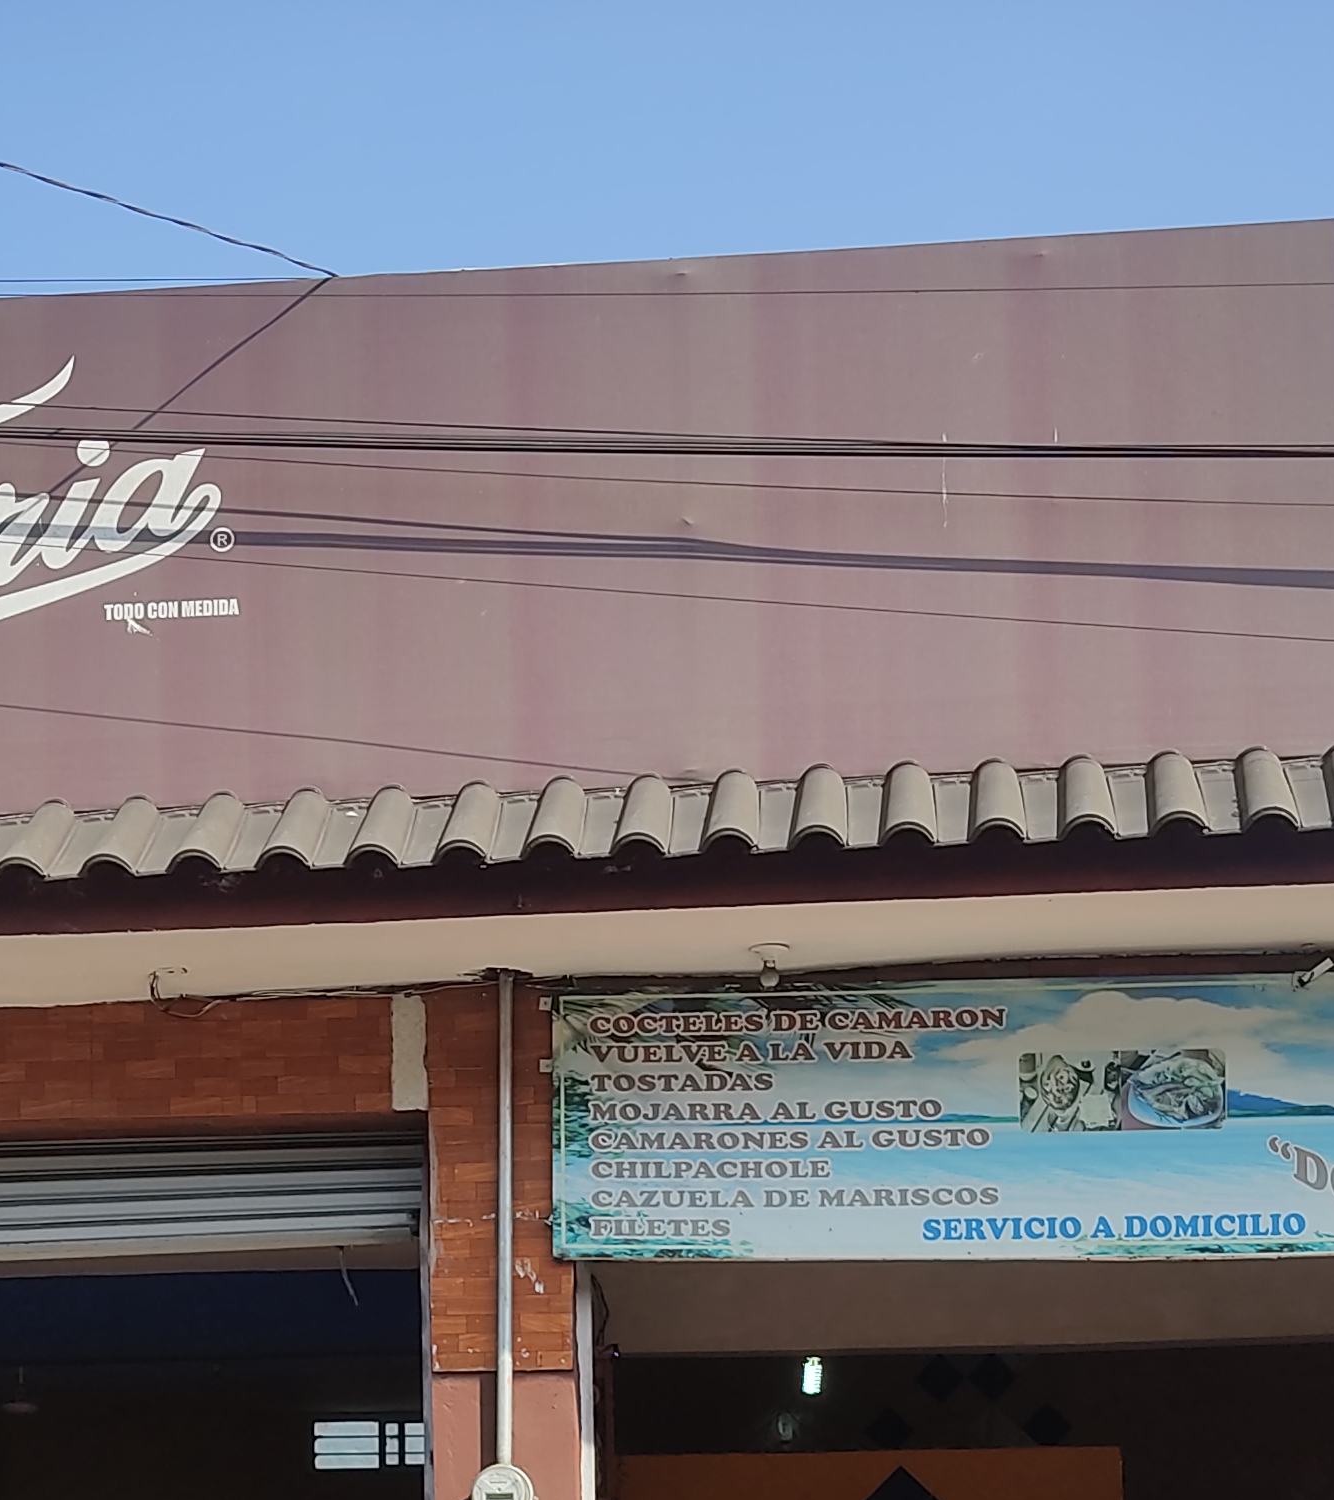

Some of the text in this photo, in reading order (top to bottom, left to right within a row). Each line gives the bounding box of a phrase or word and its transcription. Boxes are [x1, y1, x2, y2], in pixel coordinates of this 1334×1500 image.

[103, 598, 240, 621] TODO CON MEDIDA
[589, 1008, 1006, 1035] COCTELES DE CAMARON
[590, 1040, 914, 1063] VUELVE A LA VIDA
[590, 1072, 774, 1093] TOSTADAS
[590, 1099, 943, 1123] MOJARRA AL GUSTO
[590, 1128, 991, 1151] CAMARONES AL GUSTO
[590, 1159, 832, 1180] CHILPACHOLE
[590, 1186, 1000, 1209] CAZUELA DE MARISCOS
[592, 1218, 731, 1238] FILETES
[922, 1212, 1307, 1241] SERVICIO A DOMICILIO
